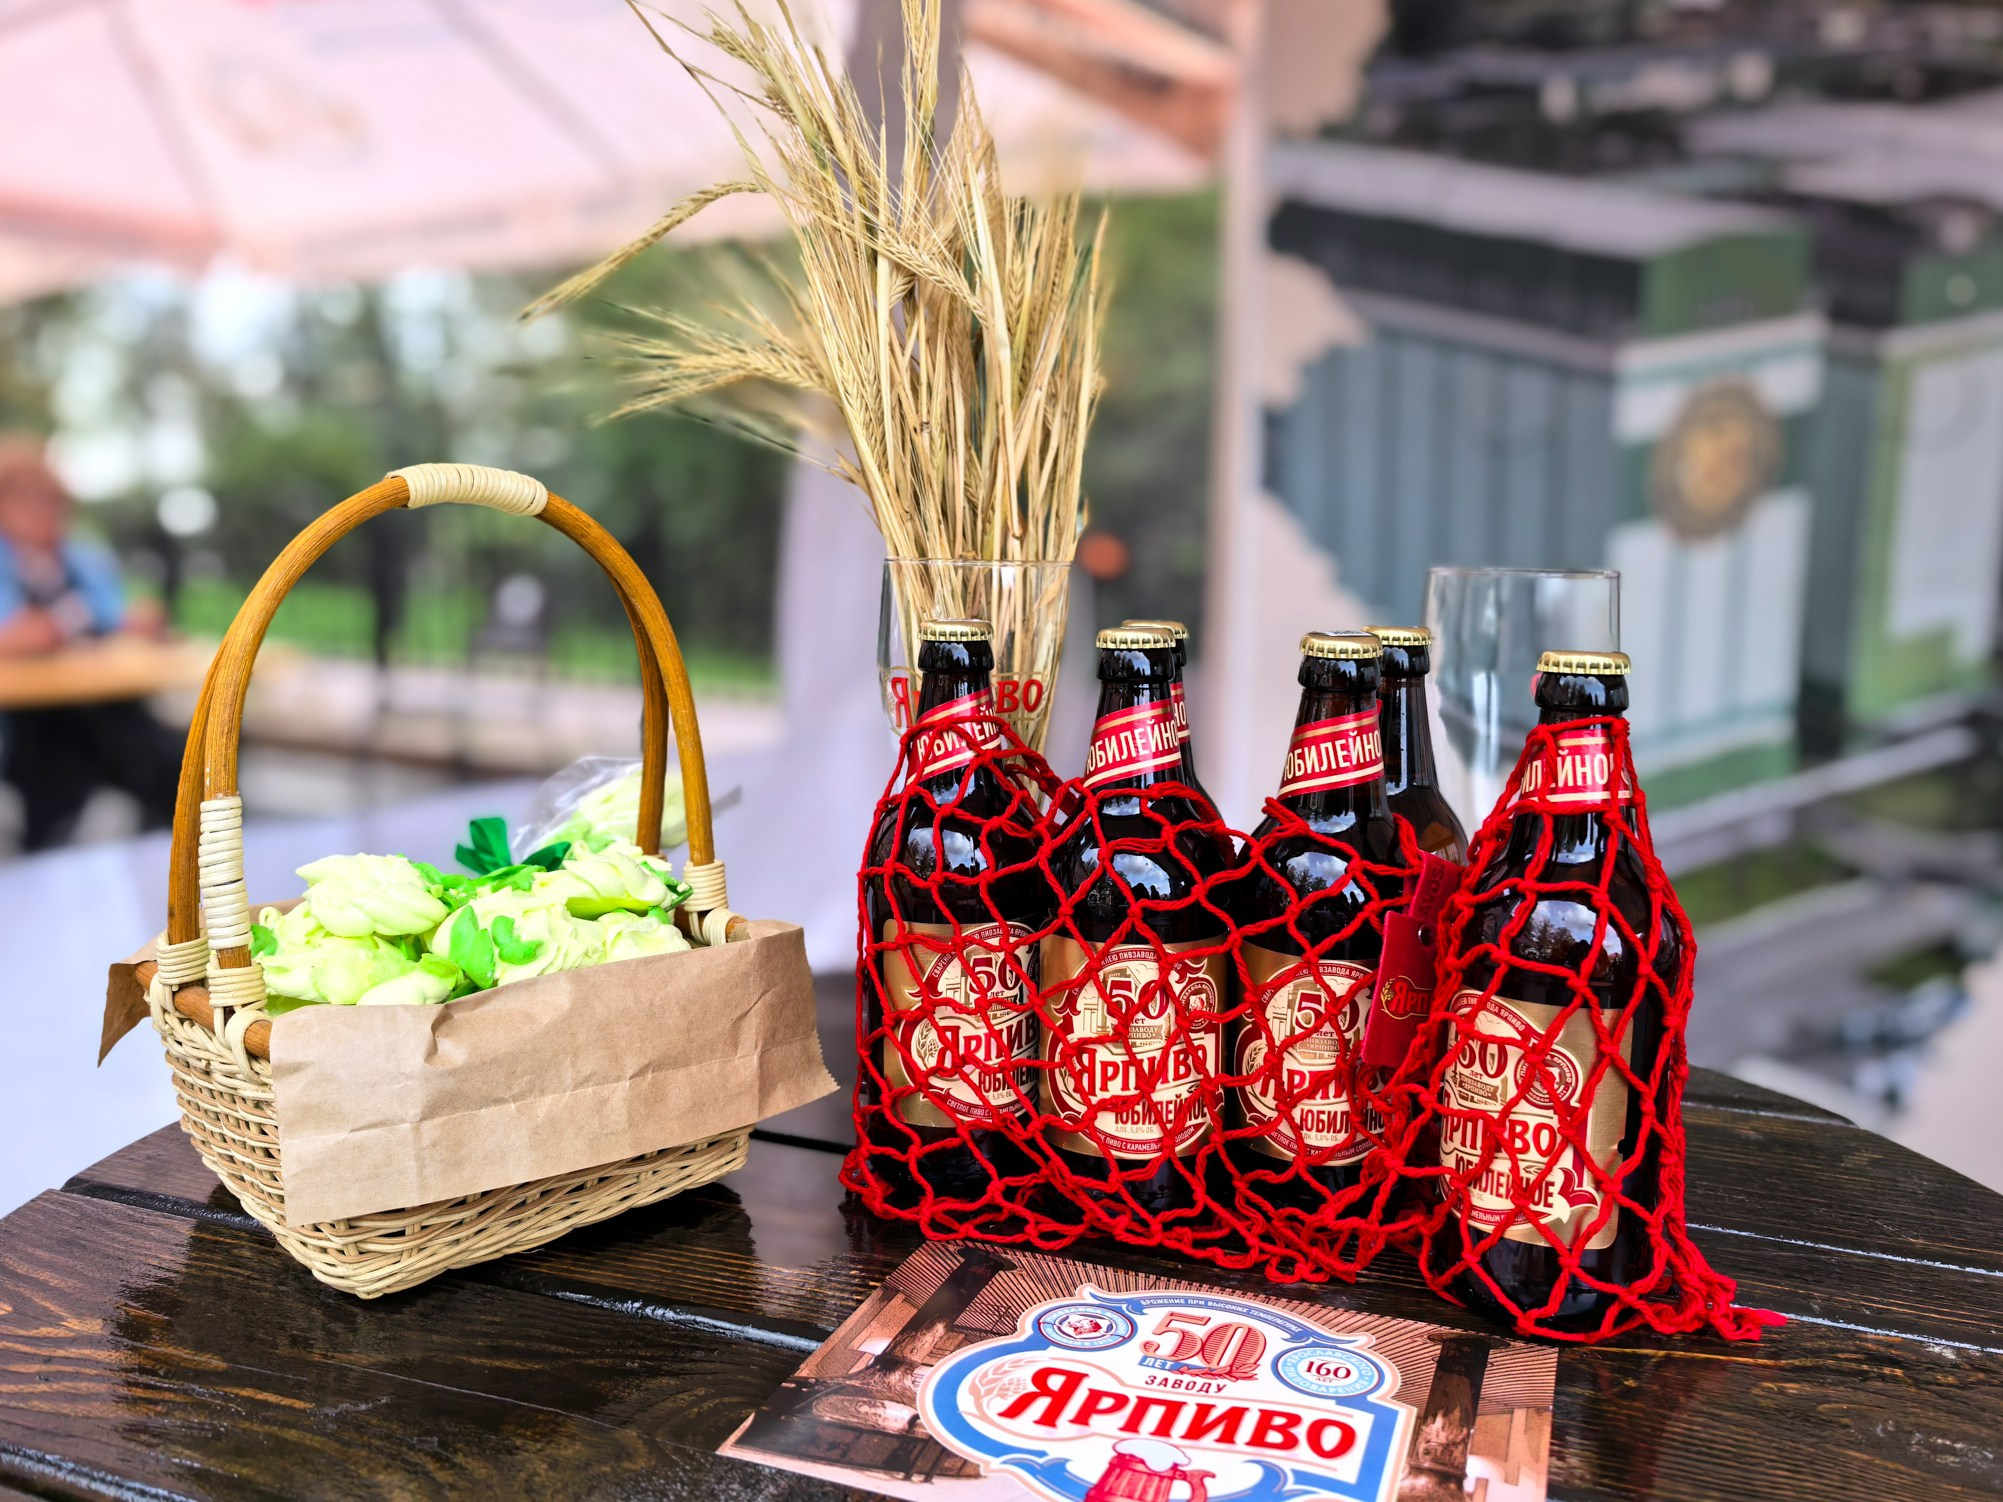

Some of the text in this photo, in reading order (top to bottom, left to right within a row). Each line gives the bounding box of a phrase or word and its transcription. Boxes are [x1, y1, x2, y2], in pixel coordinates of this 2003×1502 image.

[968, 951, 1023, 995] 50
[1318, 965, 1350, 976] ВЗАВОДА
[1107, 979, 1170, 1020] 50
[1295, 991, 1360, 1034] 50
[1499, 1008, 1526, 1032] ЯРПИВО
[1469, 1069, 1484, 1080] лет
[1140, 1298, 1185, 1306] БРОЖЕНИЕ
[1207, 1301, 1249, 1313] ВЫСОКИХ
[1139, 1310, 1267, 1370] 50
[1142, 1357, 1174, 1370] ЛЕТ
[1304, 1360, 1352, 1380] 160
[1145, 1375, 1228, 1394] ЗАВОДУ
[997, 1366, 1357, 1460] ЯРПИВО
